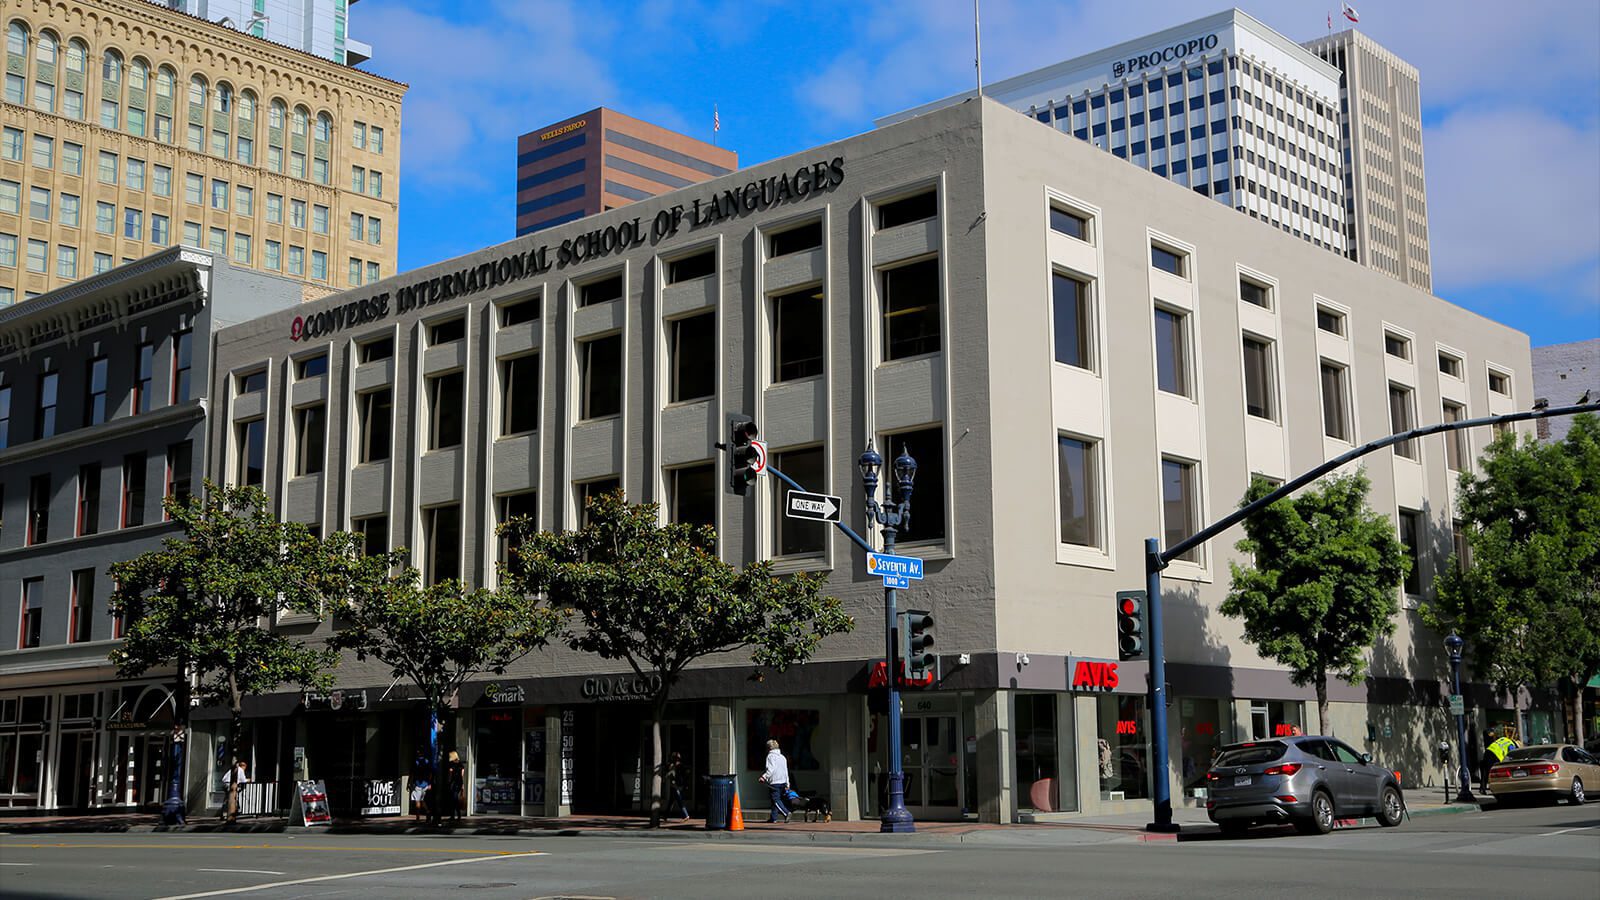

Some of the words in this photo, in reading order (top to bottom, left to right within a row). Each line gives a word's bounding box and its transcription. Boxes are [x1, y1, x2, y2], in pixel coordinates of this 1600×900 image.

[1127, 34, 1218, 74] PROCOPIO
[540, 127, 563, 141] WELLS
[563, 119, 587, 133] FARGO
[303, 292, 390, 341] CONVERSE
[396, 245, 552, 315] INTERNATIONAL
[559, 217, 646, 266] SCHOOL
[655, 204, 684, 238] OF
[693, 156, 844, 225] LANGUAGES
[795, 500, 809, 510] ONE
[811, 502, 825, 512] WAY
[868, 662, 933, 688] AS
[1073, 661, 1119, 688] AVIS
[616, 676, 628, 694] &
[917, 701, 931, 710] 640
[563, 710, 574, 722] 25
[1116, 720, 1136, 735] AVIS
[562, 735, 574, 747] 50
[370, 779, 394, 795] TIME
[528, 783, 543, 801] 19
[562, 779, 573, 791] 80
[373, 793, 394, 806] OUT
